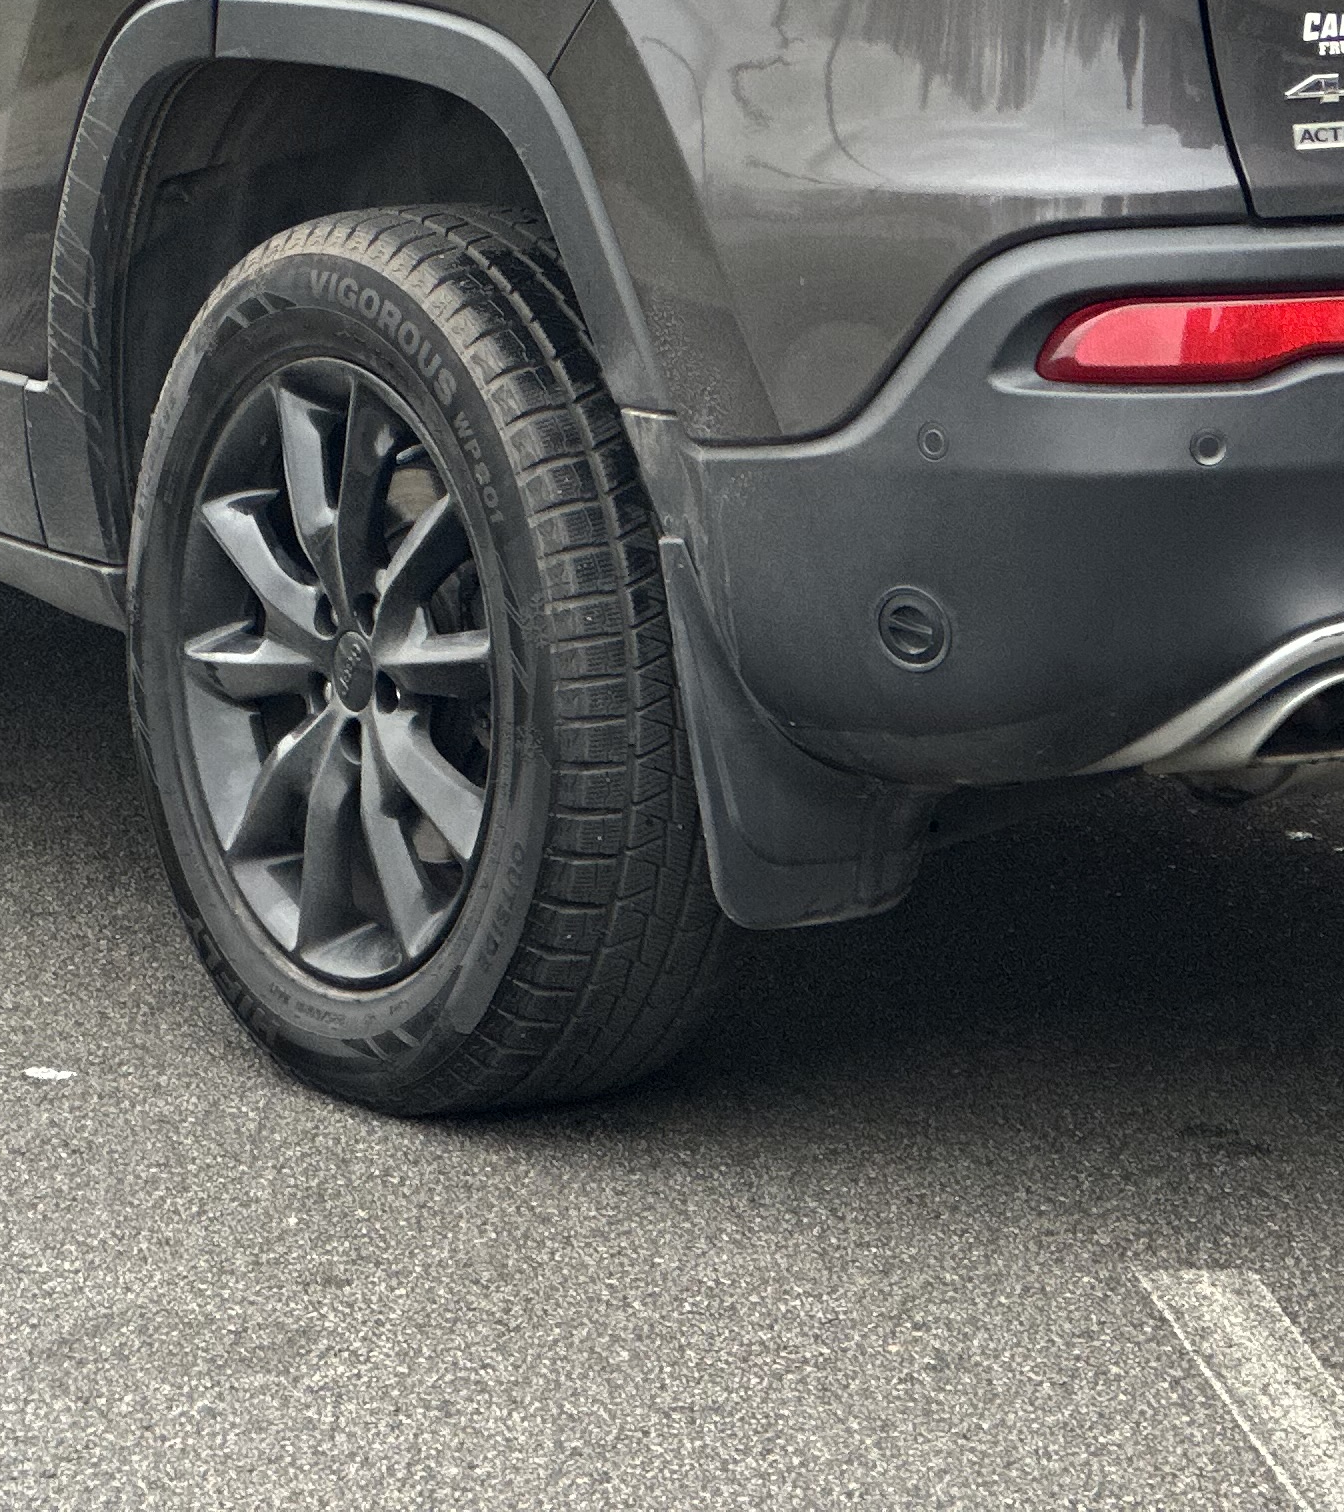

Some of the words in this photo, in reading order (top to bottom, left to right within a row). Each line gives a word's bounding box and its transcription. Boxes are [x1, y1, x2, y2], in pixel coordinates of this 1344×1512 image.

[310, 270, 458, 406] VIGOROUS
[453, 411, 505, 524] WP801
[478, 841, 525, 971] OUTSIDE
